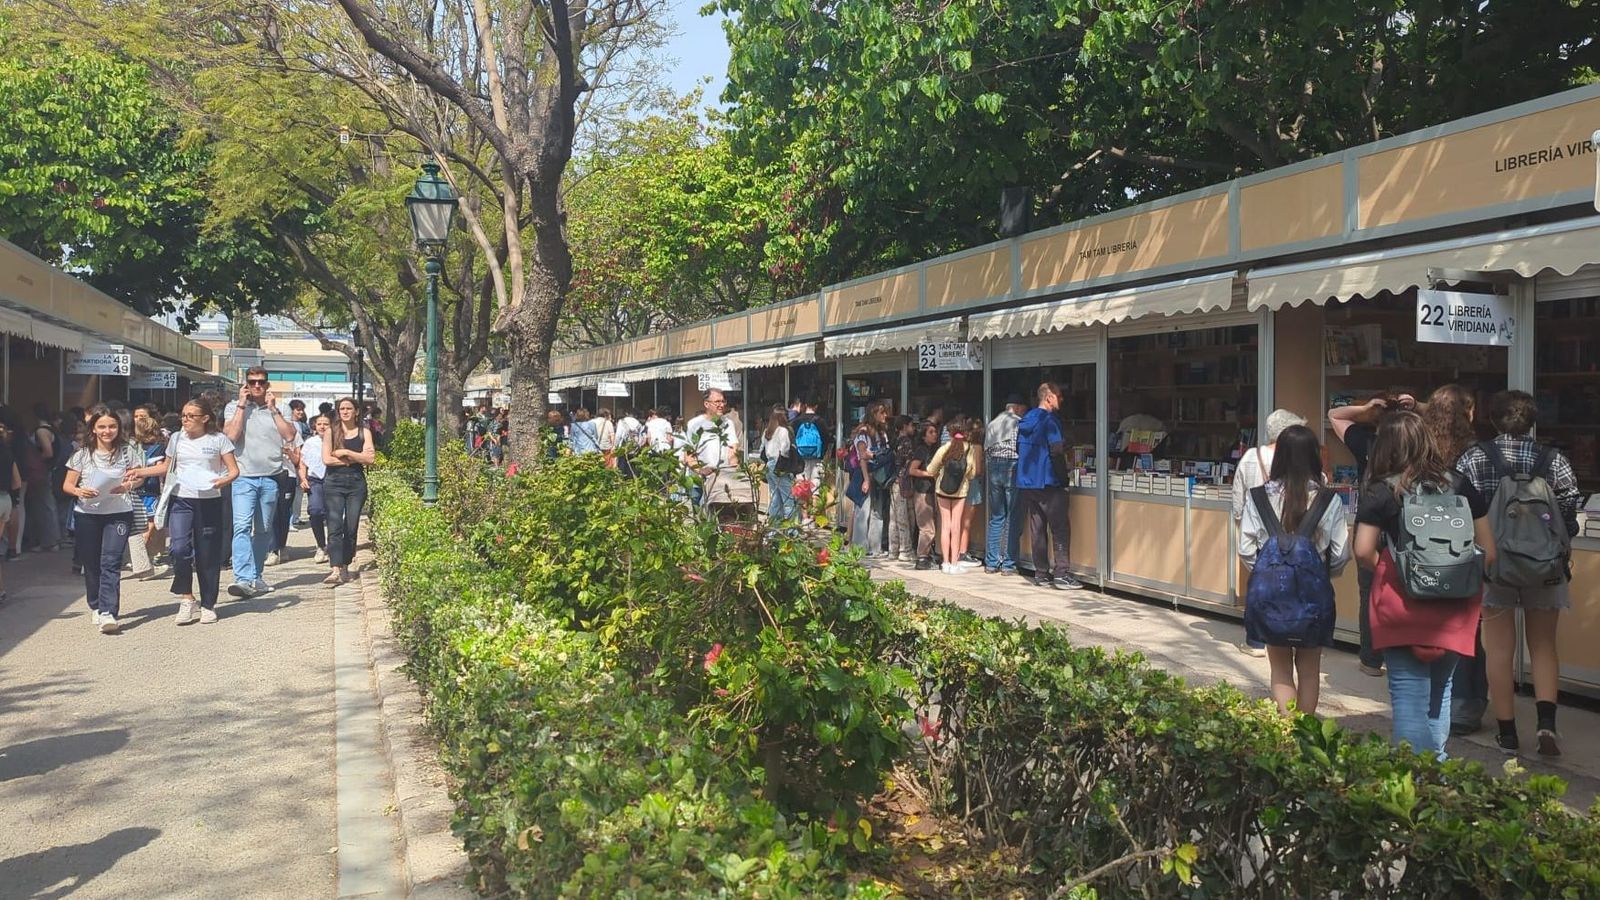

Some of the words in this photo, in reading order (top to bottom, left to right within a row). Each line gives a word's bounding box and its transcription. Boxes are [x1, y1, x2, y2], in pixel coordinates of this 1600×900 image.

[1495, 145, 1563, 172] LIBRERÍA
[1566, 140, 1596, 157] VIR
[1079, 248, 1092, 259] TAM
[1093, 246, 1106, 257] TAM
[1420, 304, 1444, 326] 22
[1448, 304, 1492, 318] LIBRERÍA
[1448, 320, 1496, 334] VIRIDIANA
[920, 344, 936, 356] 23
[114, 356, 128, 364] 48
[921, 358, 936, 368] 24
[113, 365, 128, 374] 49
